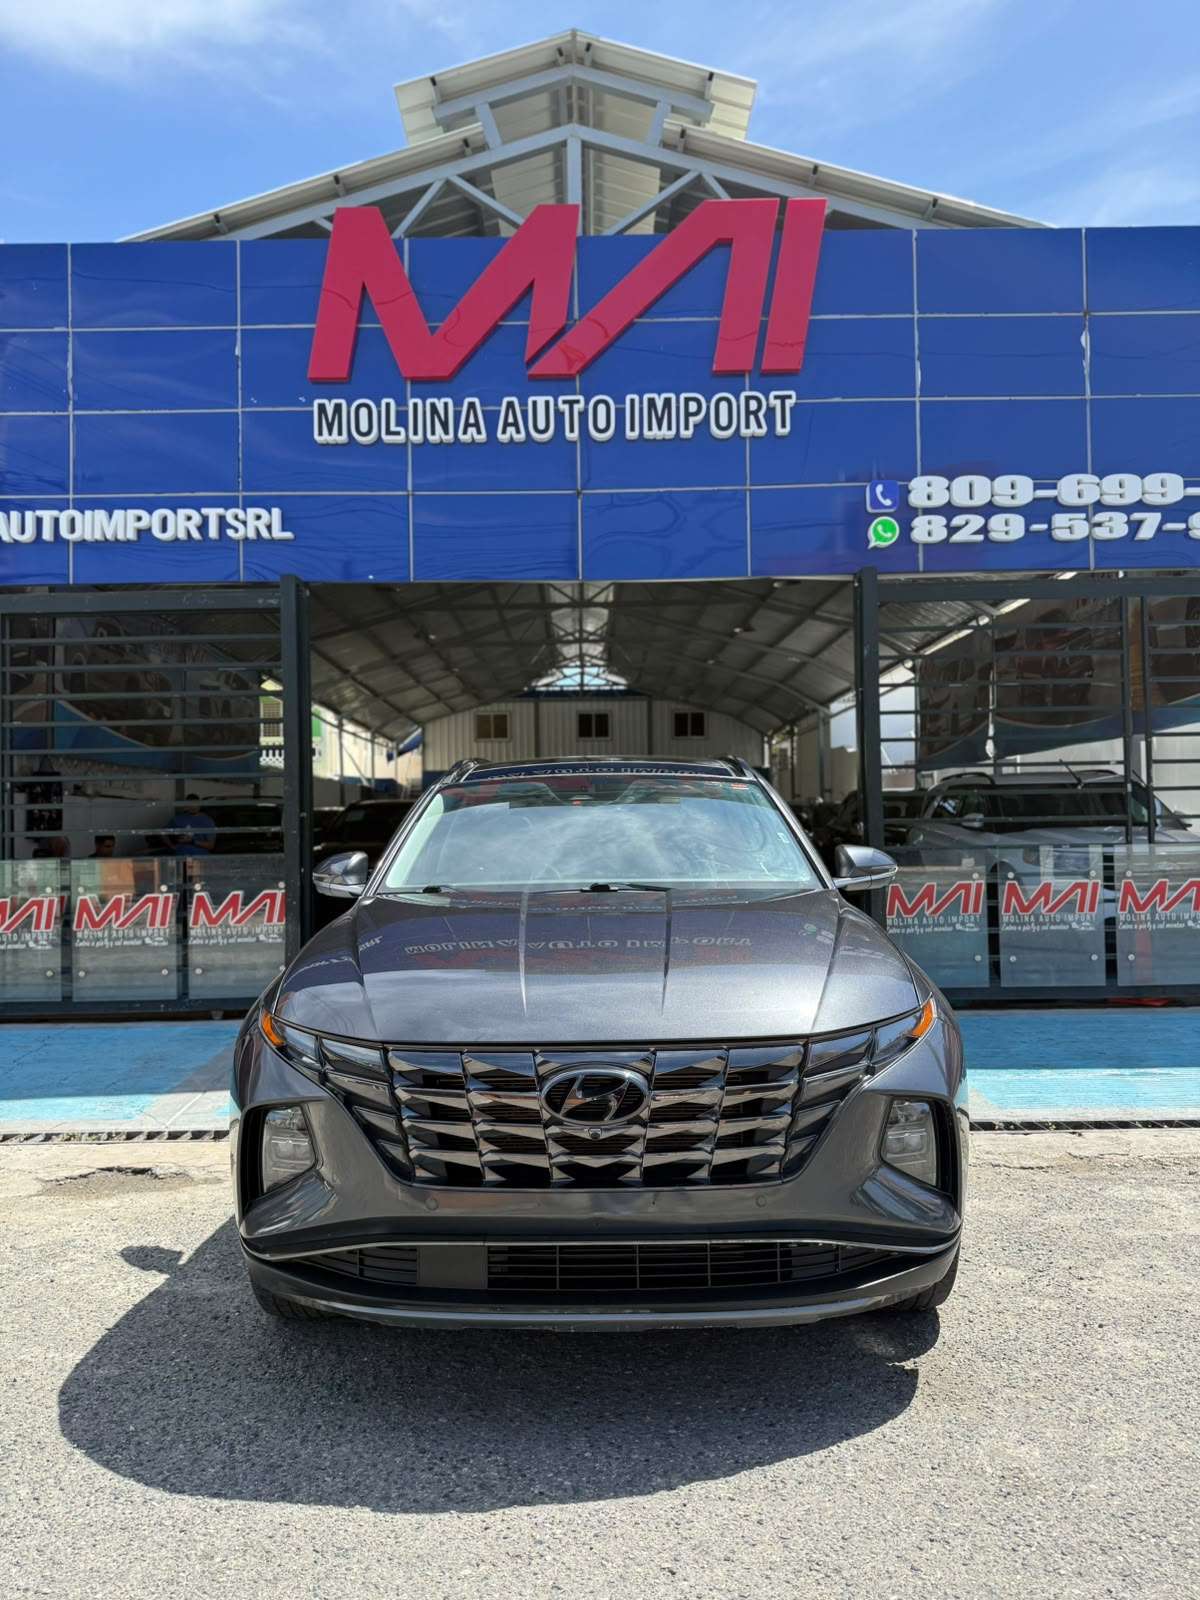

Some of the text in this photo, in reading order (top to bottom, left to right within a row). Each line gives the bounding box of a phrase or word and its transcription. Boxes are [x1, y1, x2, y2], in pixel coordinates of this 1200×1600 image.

[308, 199, 827, 380] MAI
[313, 390, 796, 444] MOLINA AUTO IMPORT
[0, 897, 57, 933] AI
[73, 893, 173, 931] MAI
[189, 890, 286, 928] MAI
[886, 881, 984, 917] MAI
[1002, 879, 1100, 915] MAI
